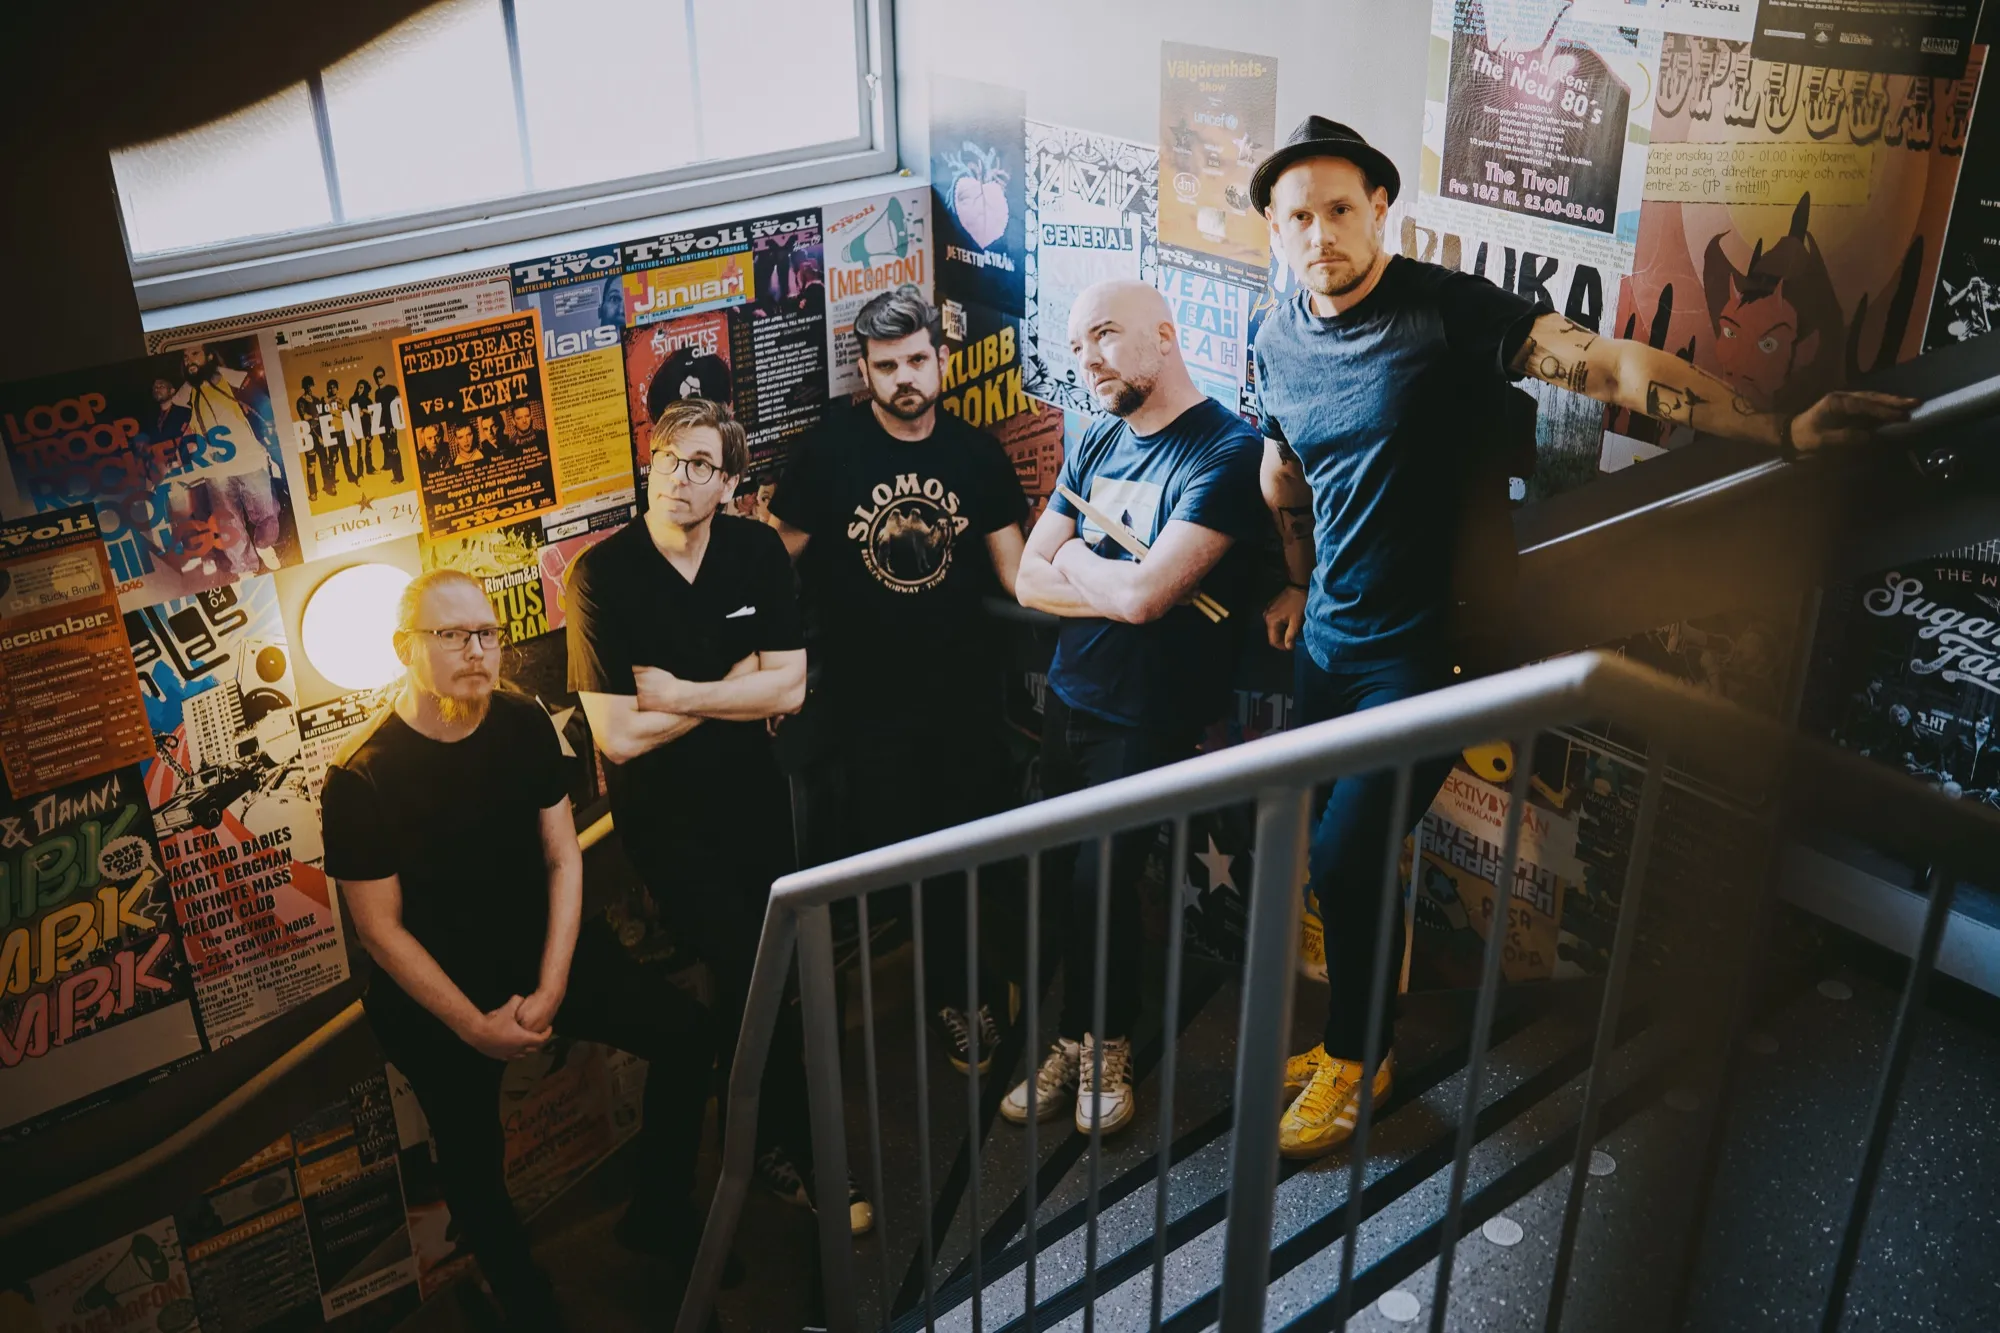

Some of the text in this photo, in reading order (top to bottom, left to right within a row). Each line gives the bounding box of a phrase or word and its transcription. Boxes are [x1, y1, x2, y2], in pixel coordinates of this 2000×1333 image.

[1690, 0, 1740, 13] Tivoli
[1167, 58, 1267, 82] Välgörenhets-
[1473, 50, 1504, 80] The
[1510, 66, 1555, 103] New
[1199, 81, 1227, 93] Show
[1194, 111, 1225, 128] unicef
[1676, 149, 1713, 165] onsdag
[1485, 160, 1570, 197] The Tivoli
[1771, 168, 1810, 184] grunge
[1449, 178, 1469, 196] Fre
[1524, 193, 1605, 225] 23.00-03.00
[750, 214, 819, 239] ivoli
[752, 219, 779, 228] The
[826, 203, 877, 235] Tivoli
[625, 226, 747, 263] Tivoli
[660, 232, 694, 246] The
[1042, 223, 1134, 251] GENERAL
[515, 247, 622, 284] Tivol
[551, 252, 588, 265] The
[663, 255, 677, 266] LIVE
[1157, 247, 1222, 275] Tivoli
[556, 277, 570, 287] LIVE
[634, 269, 745, 313] Januari
[1162, 264, 1239, 309] YEAH
[404, 327, 536, 376] TEDDYBEARS
[942, 325, 1016, 393] KLUBB
[1180, 327, 1239, 367] EAH
[468, 349, 536, 382] STHLM
[315, 402, 339, 414] Von
[420, 396, 454, 416] vs.
[459, 373, 529, 413] KENT
[4, 392, 107, 445] LOOP
[292, 396, 407, 454] BENZO
[17, 416, 141, 472] TROOP
[434, 503, 456, 516] Fre
[458, 496, 474, 509] 13
[476, 487, 505, 505] April
[532, 480, 542, 490] 22
[447, 487, 471, 499] Support
[847, 472, 970, 543] SLOMOSA
[451, 498, 535, 531] Tivoli
[0, 513, 95, 549] voli
[1934, 567, 1972, 583] THE
[209, 594, 227, 609] 04
[0, 610, 110, 652] ecember
[304, 713, 364, 739] NATTKLUBB LIVE
[184, 831, 220, 856] LEVA
[241, 826, 293, 857] BABIES
[105, 850, 144, 872] TOUR
[117, 860, 142, 876] 2007
[173, 847, 293, 901] MARIT BERGMAN
[185, 869, 293, 919] INFINITE MASS
[182, 894, 276, 938] MELODY CLUB
[233, 928, 283, 956] CENTURY
[284, 912, 317, 936] NOISE
